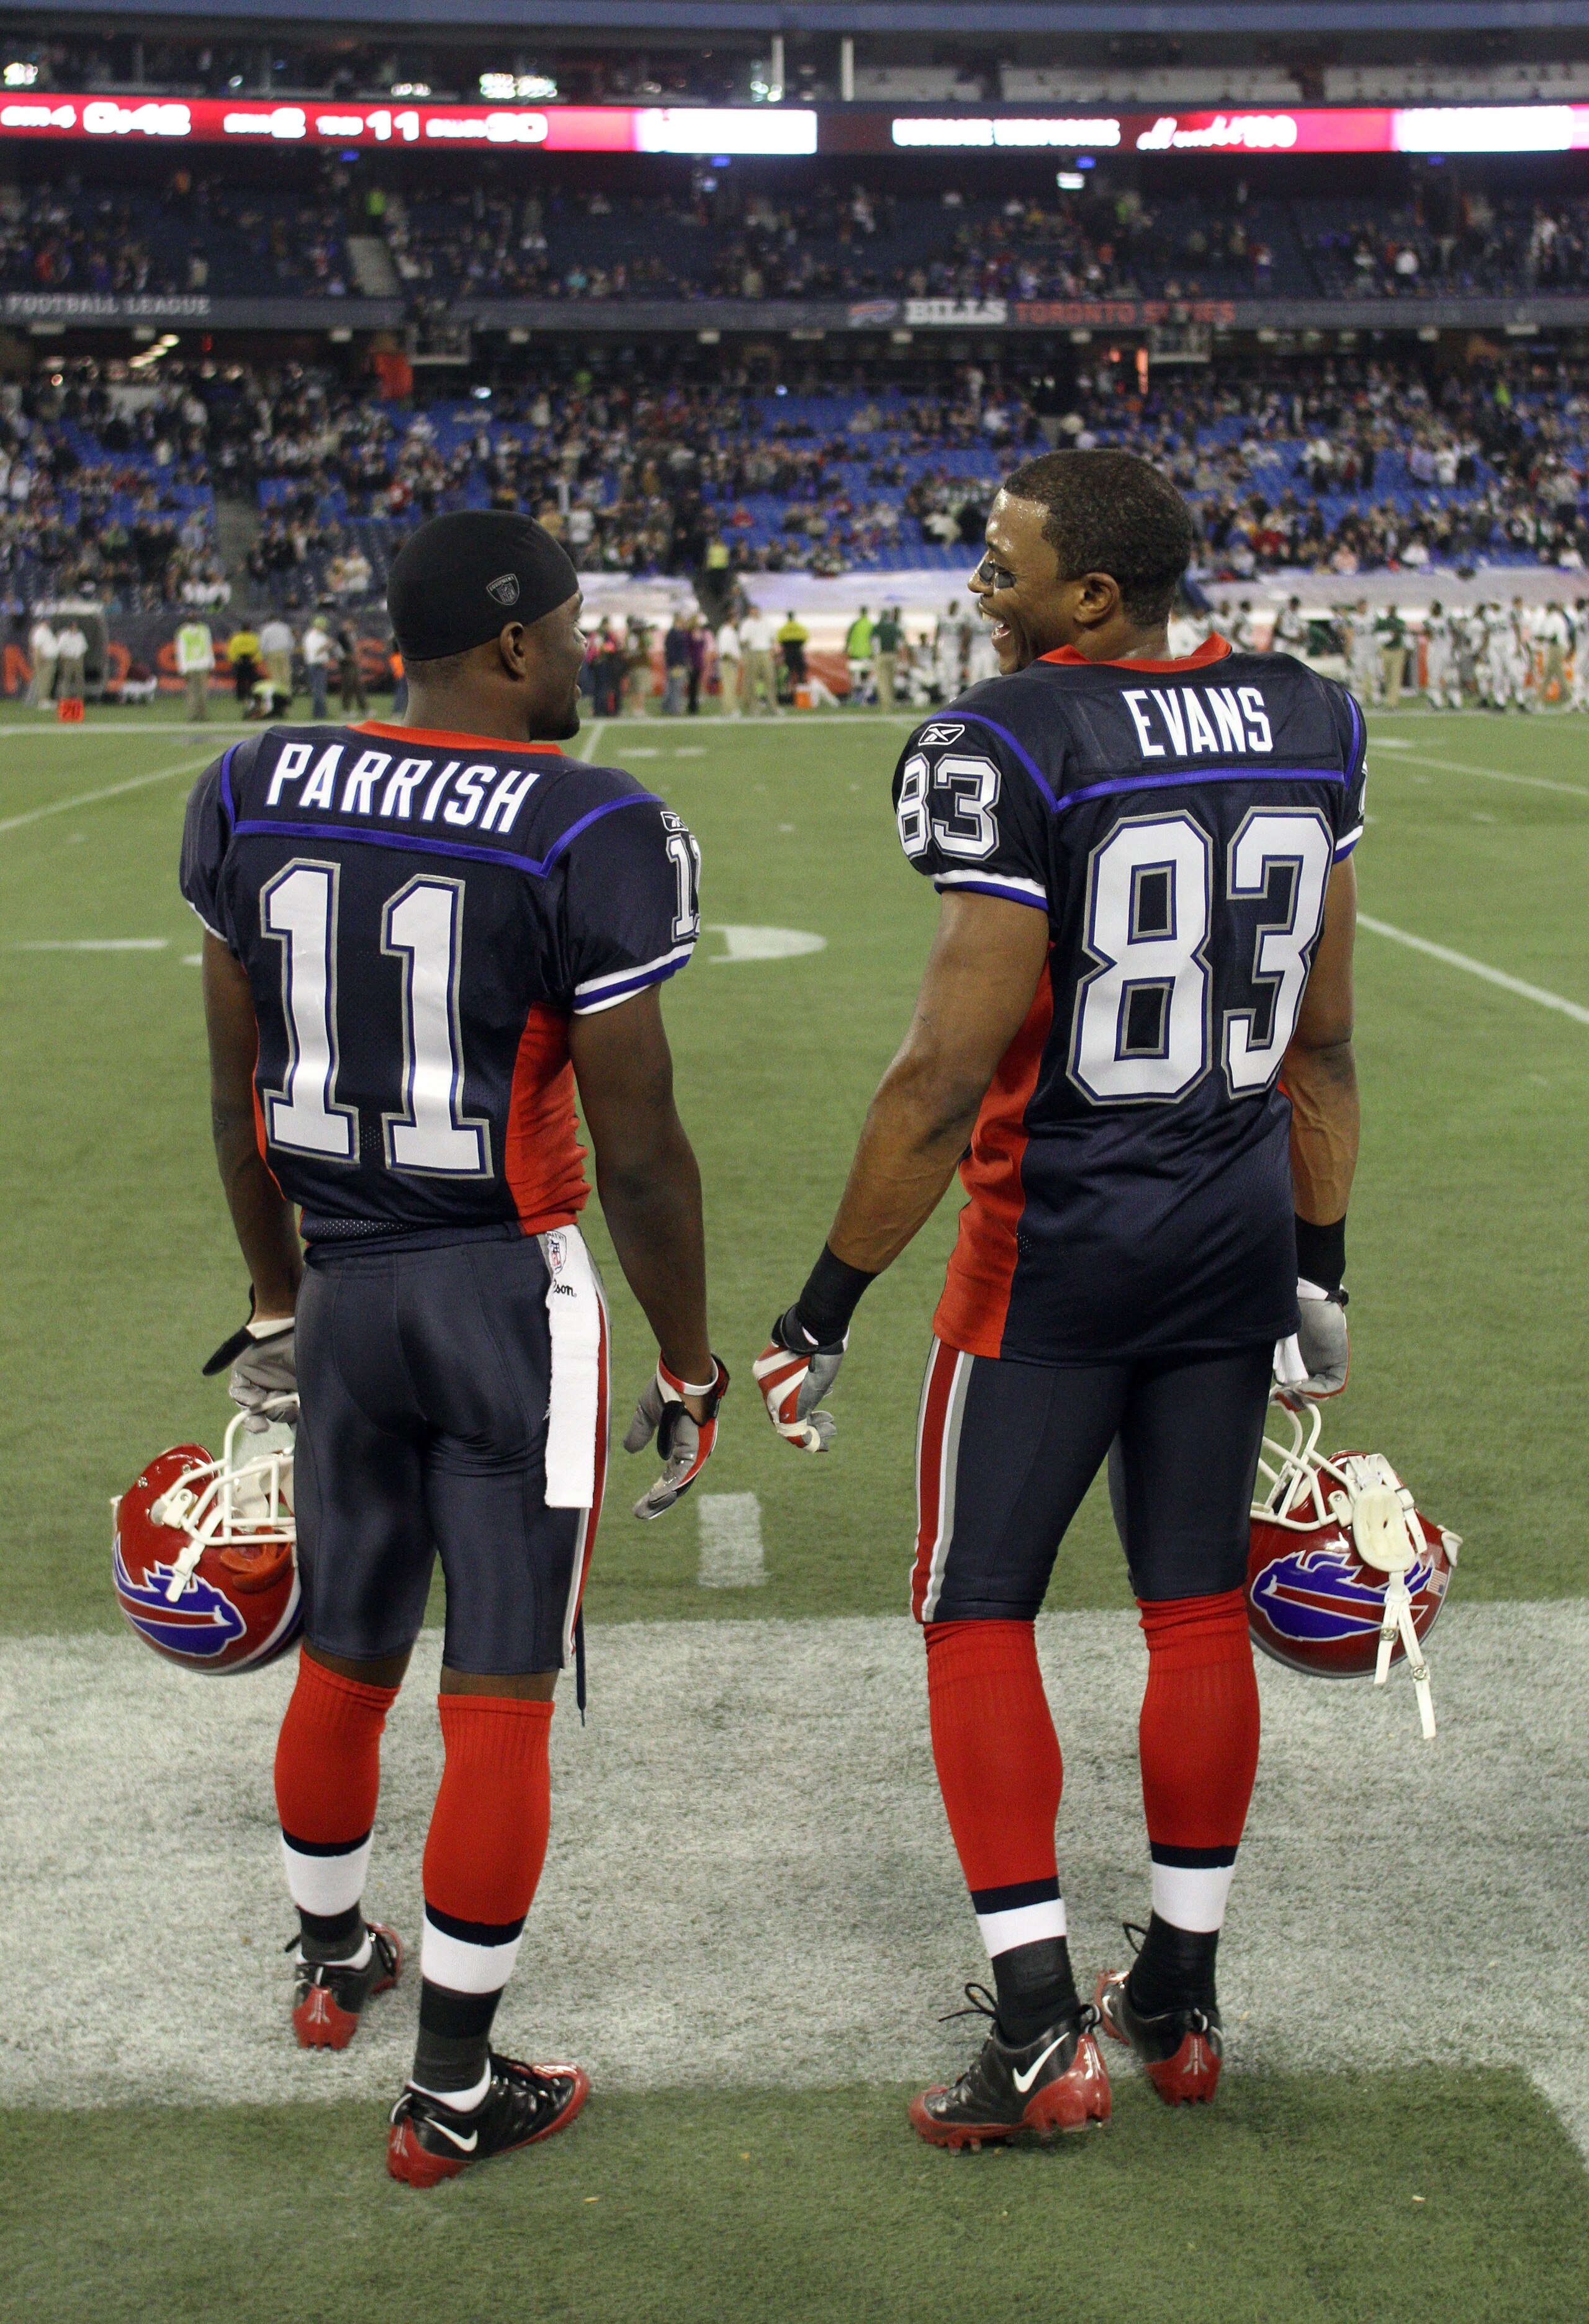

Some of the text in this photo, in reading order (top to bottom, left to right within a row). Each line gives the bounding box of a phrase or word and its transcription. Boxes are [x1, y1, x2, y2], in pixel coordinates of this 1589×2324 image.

[366, 110, 420, 141] 11
[6, 294, 211, 316] FOOTBALL LEAGUE
[904, 298, 1007, 325] BILLS
[1015, 302, 1135, 325] TORONTO
[1122, 687, 1275, 758] EVANS
[265, 743, 540, 834] PARRISH
[896, 753, 1001, 861] 83
[1065, 806, 1334, 1106] 83
[259, 857, 495, 1179] 11
